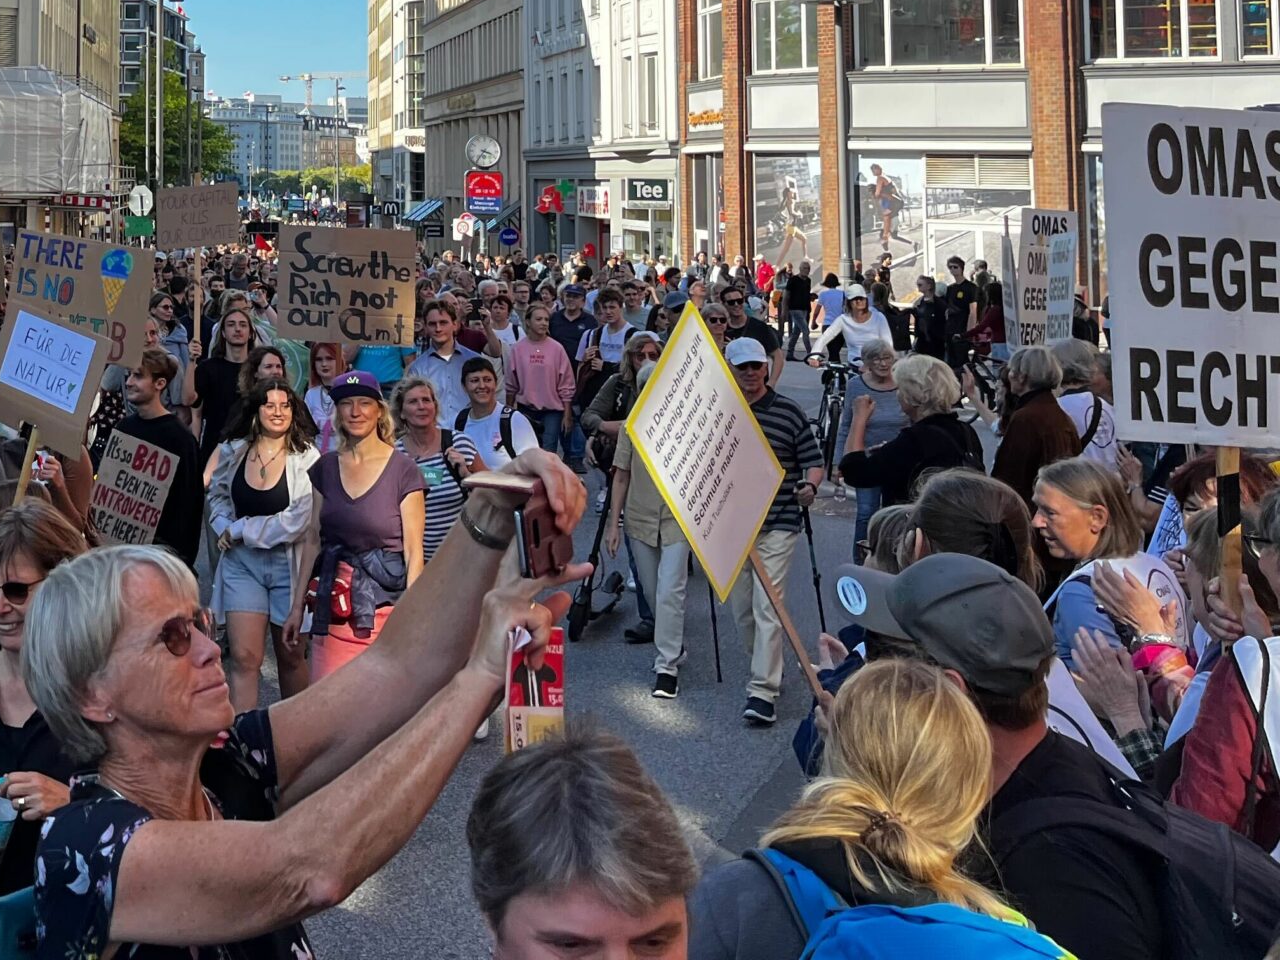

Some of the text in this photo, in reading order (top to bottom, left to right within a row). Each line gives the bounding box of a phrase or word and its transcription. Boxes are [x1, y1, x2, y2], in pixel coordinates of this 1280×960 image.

[159, 193, 188, 210] YOUR
[632, 181, 664, 199] Tee
[161, 223, 236, 245] OUR CLIMATE
[181, 209, 209, 225] KILLS
[1032, 214, 1068, 236] OMAS
[21, 233, 88, 271] THERE
[289, 231, 411, 282] Screw the
[1027, 251, 1048, 276] OMA
[16, 267, 75, 306] IS NO
[288, 272, 398, 310] Rich not
[1138, 232, 1280, 313] GEGE
[287, 308, 334, 328] our
[1023, 286, 1047, 311] GEGE
[23, 327, 82, 367] FÜR DIE
[107, 321, 127, 363] B
[645, 333, 702, 440] In Deutschland gilt
[654, 356, 705, 455] derjenige der auf
[697, 412, 709, 431] für
[706, 388, 720, 410] viel
[662, 393, 703, 469] den Schmutz
[131, 444, 172, 482] BAD
[678, 409, 725, 500] gefährlicher als
[686, 412, 737, 512] derjenige der den
[92, 483, 161, 528] INTROVERTS
[115, 469, 158, 503] EVEN THE
[693, 474, 723, 526] Schmutz
